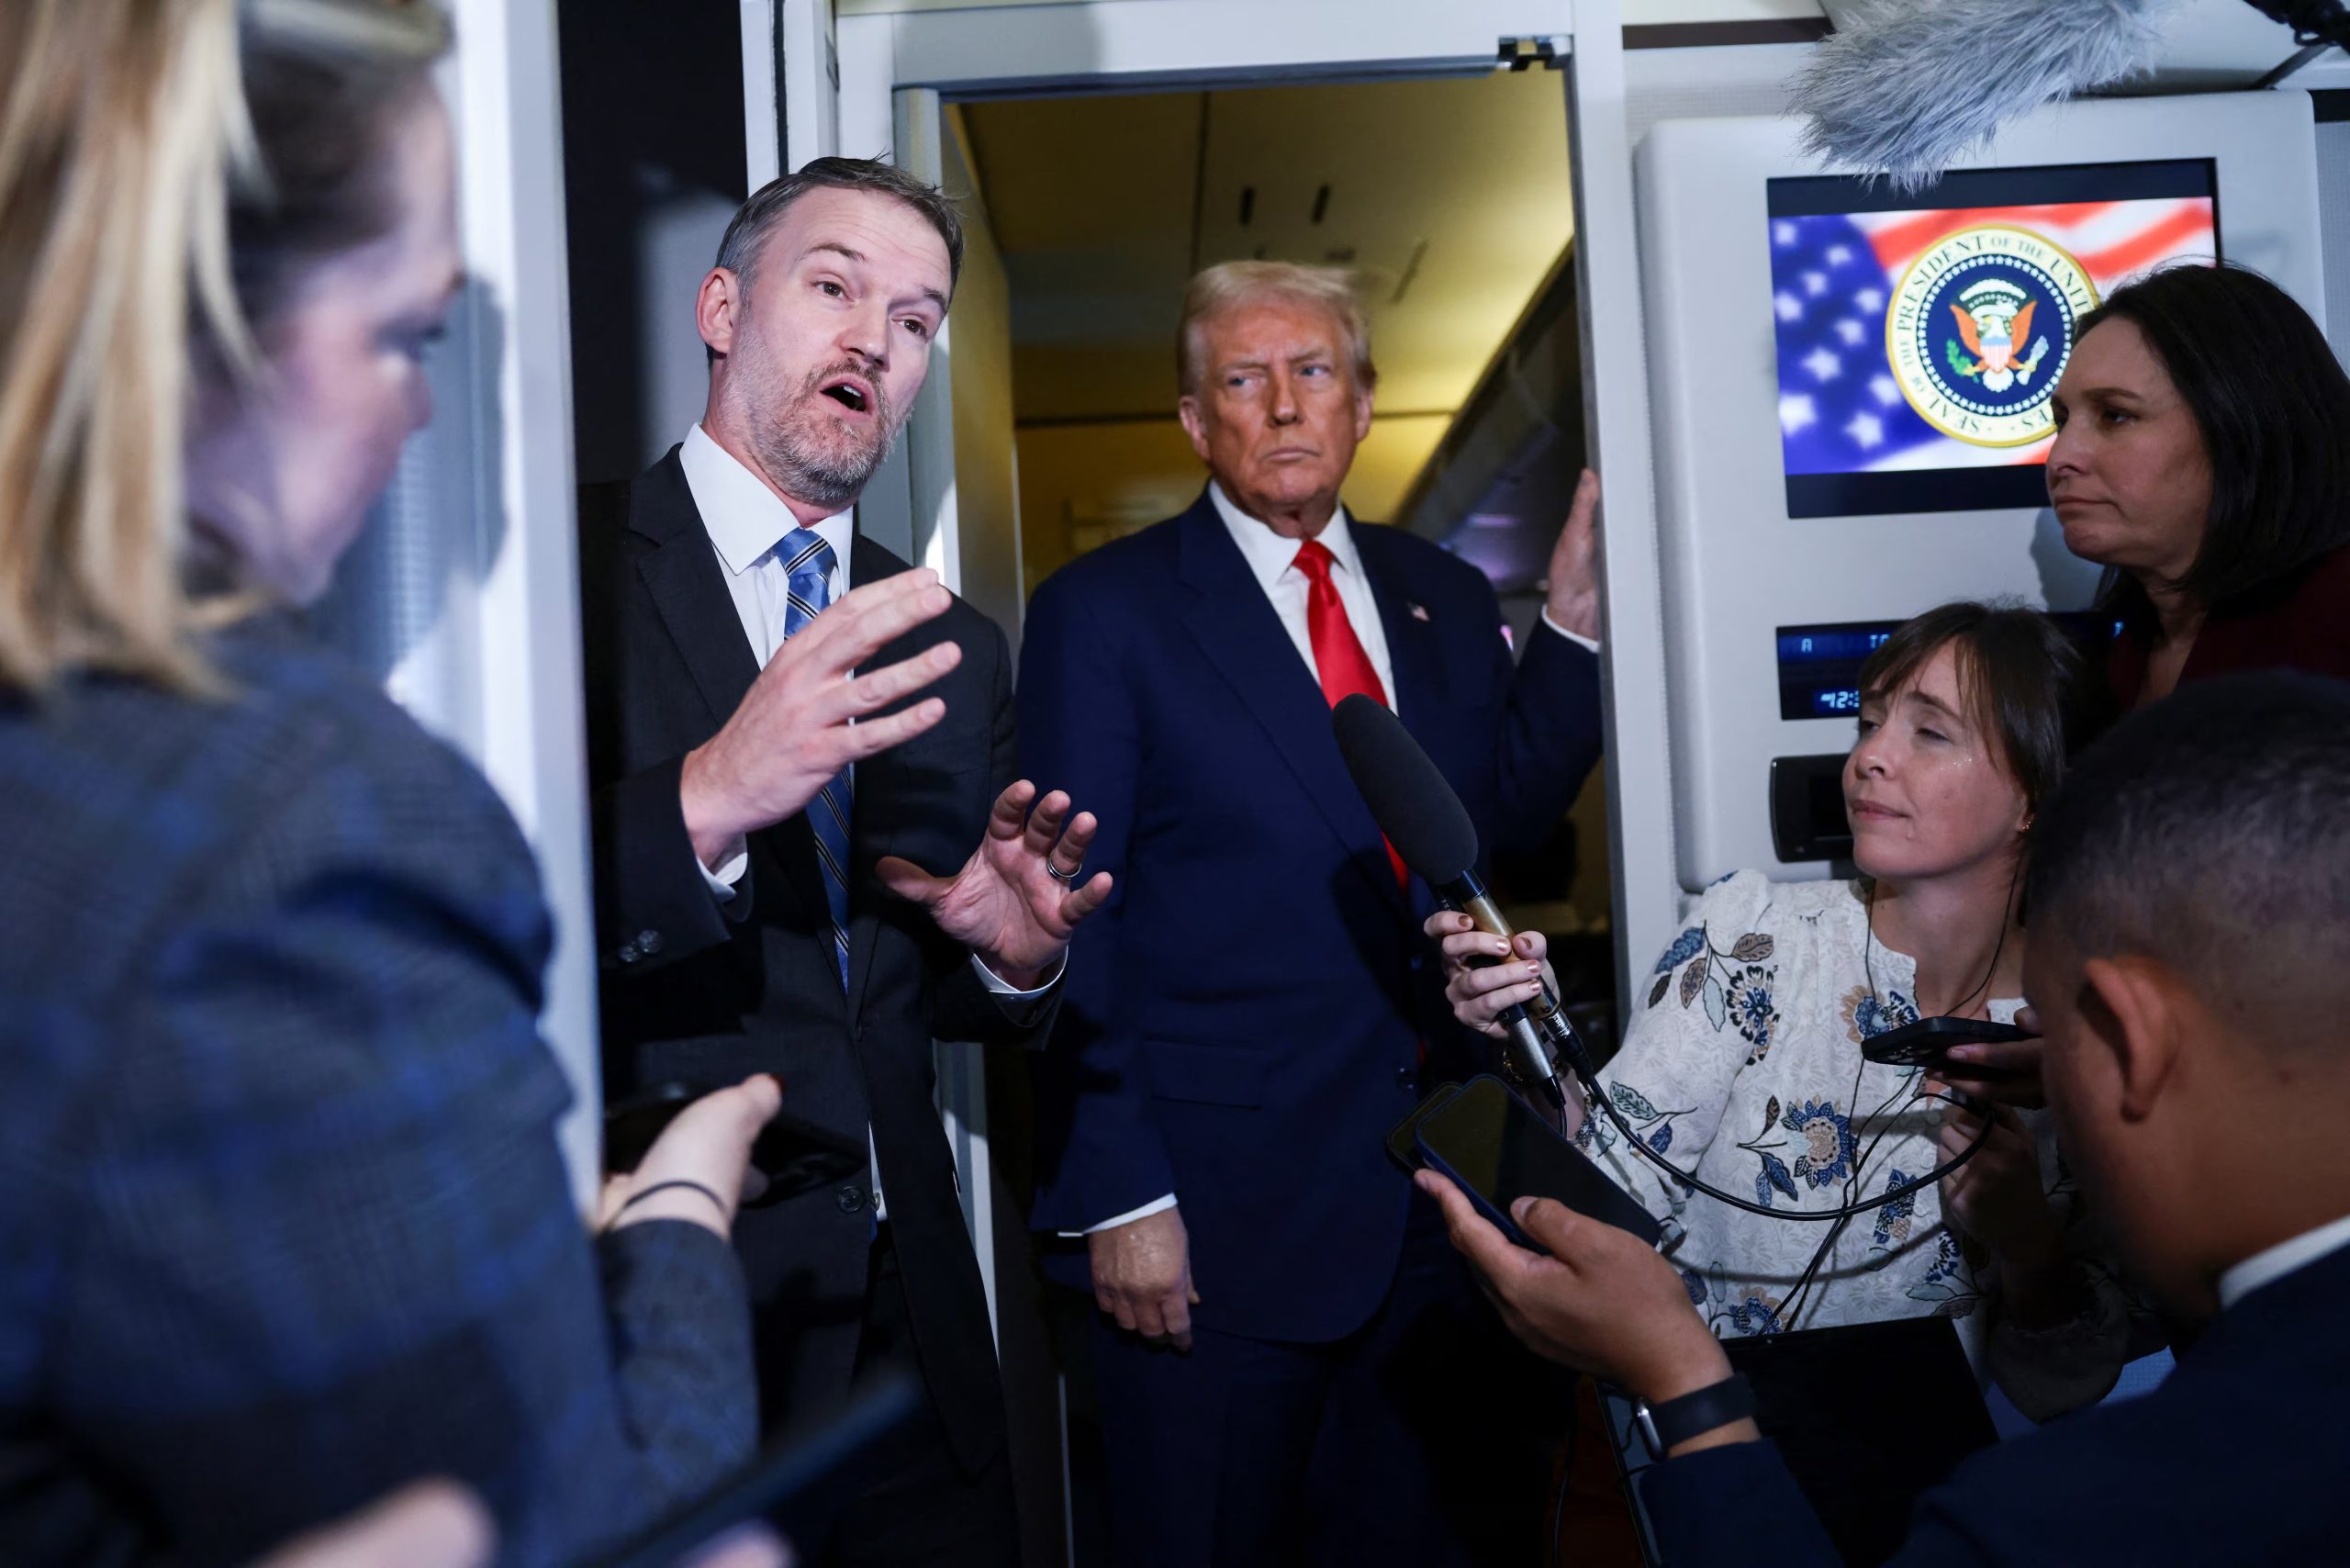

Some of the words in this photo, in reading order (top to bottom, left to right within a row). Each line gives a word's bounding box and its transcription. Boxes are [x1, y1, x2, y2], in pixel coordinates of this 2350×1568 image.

[1990, 236, 2010, 248] OF
[2018, 240, 2044, 258] THE
[1897, 234, 1985, 330] PRESIDENT
[1899, 339, 1916, 365] THE
[1928, 398, 1980, 432] SEAL
